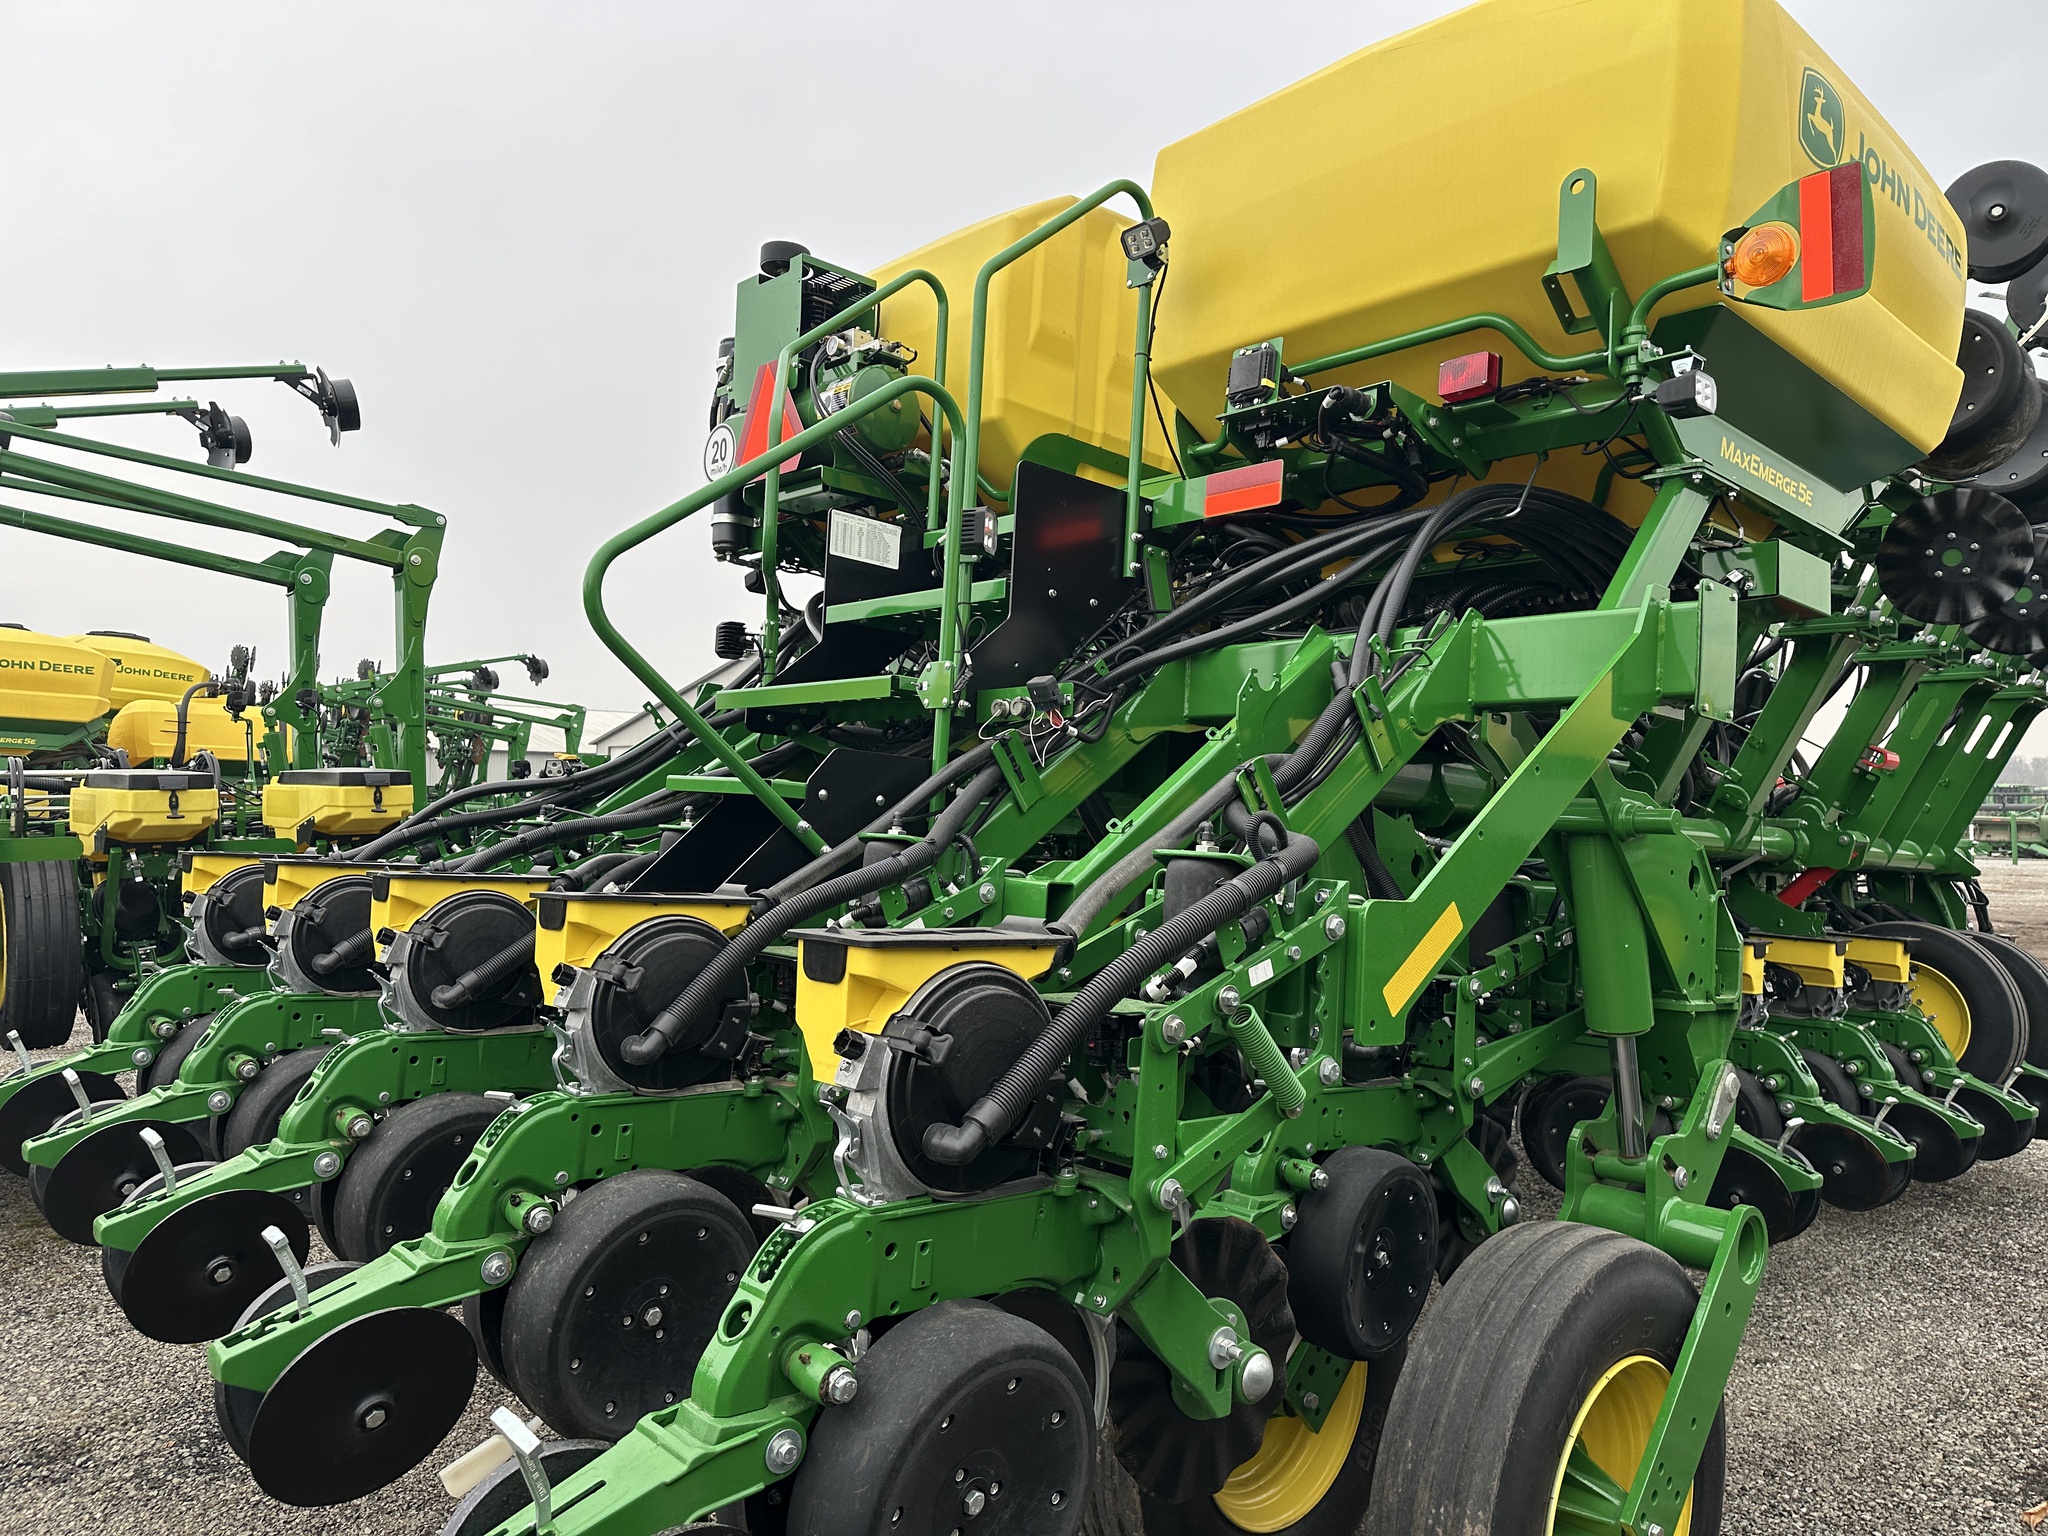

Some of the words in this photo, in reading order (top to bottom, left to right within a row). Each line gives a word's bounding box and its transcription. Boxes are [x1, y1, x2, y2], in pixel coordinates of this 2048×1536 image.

[1849, 130, 1910, 217] JOHN
[1914, 186, 1963, 281] DEERE
[711, 438, 727, 465] 20
[1798, 481, 1814, 508] 5E
[39, 660, 95, 676] DEERE
[116, 665, 151, 677] JOHN
[153, 669, 194, 683] DEERE
[24, 737, 37, 745] 5E
